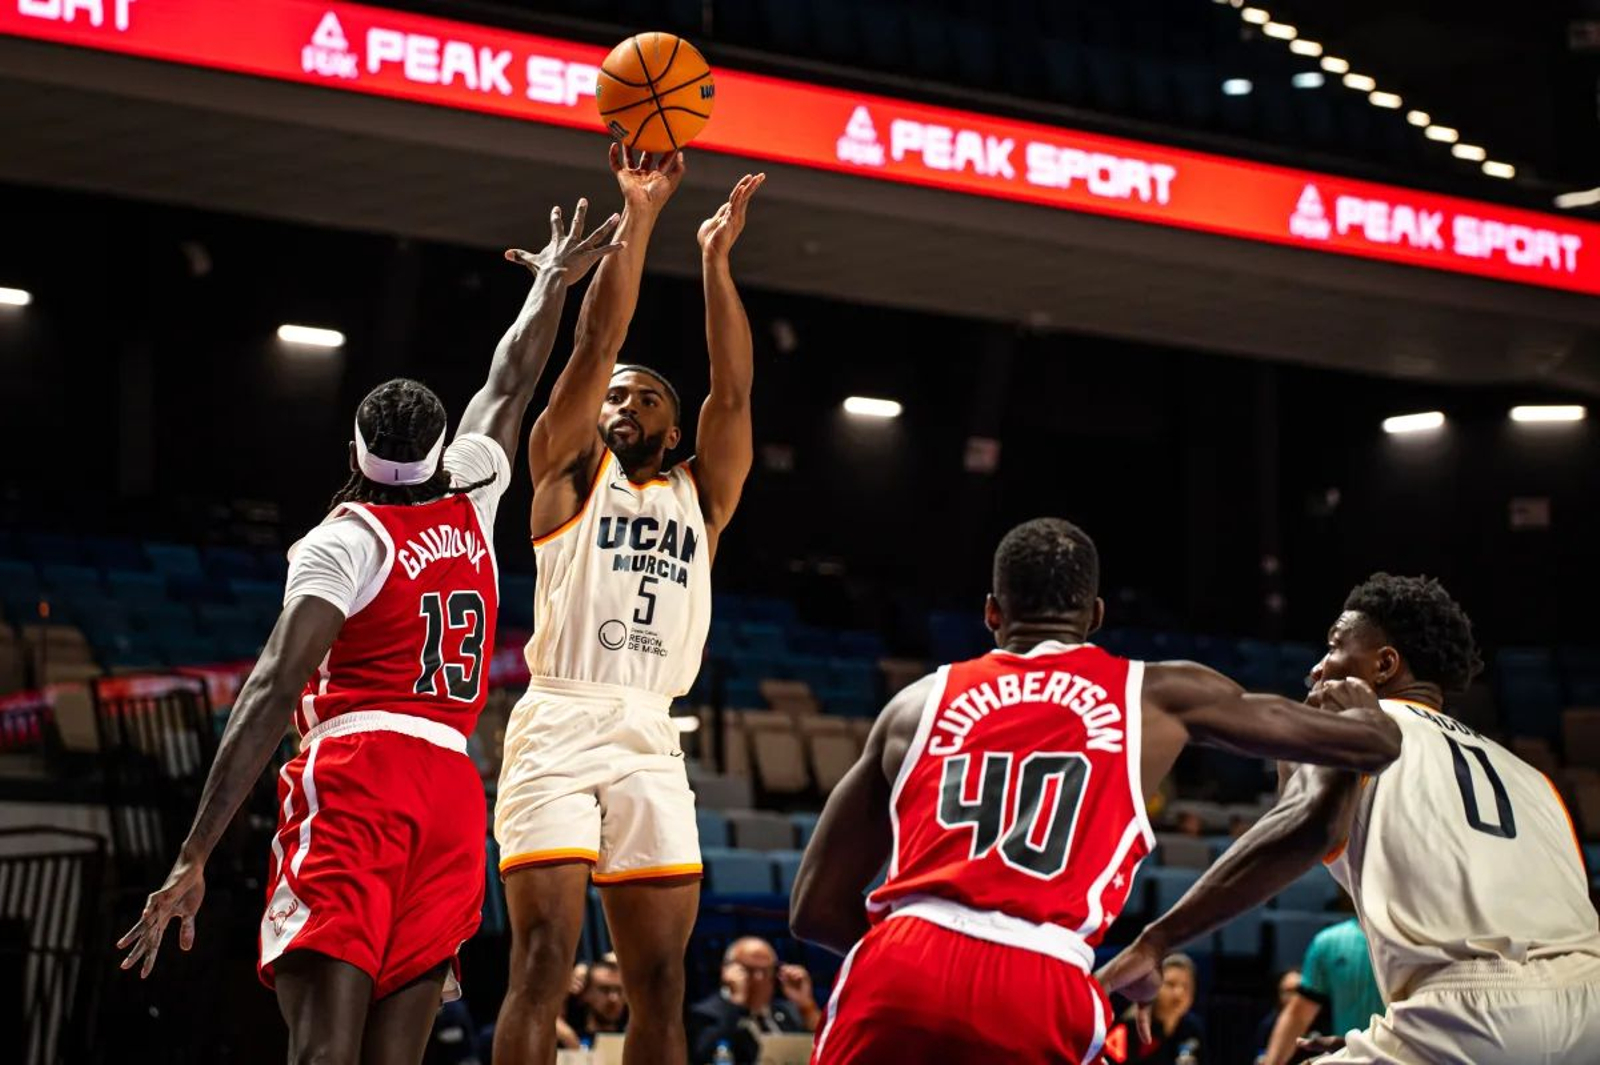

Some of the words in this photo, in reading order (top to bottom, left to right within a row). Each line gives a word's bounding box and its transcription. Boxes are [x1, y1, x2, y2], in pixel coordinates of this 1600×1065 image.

[367, 27, 512, 95] PEAK
[526, 54, 599, 107] SP
[891, 119, 1015, 180] PEAK
[1026, 141, 1176, 205] SPORT
[1335, 195, 1444, 250] PEAK
[1453, 215, 1581, 273] SPORT
[612, 554, 688, 588] MURCIA
[632, 575, 659, 625] 5
[413, 590, 486, 703] 13
[628, 642, 640, 651] DE
[928, 671, 1123, 756] CUTHBERTSON
[936, 751, 1092, 881] 40
[1442, 731, 1517, 839] 0
